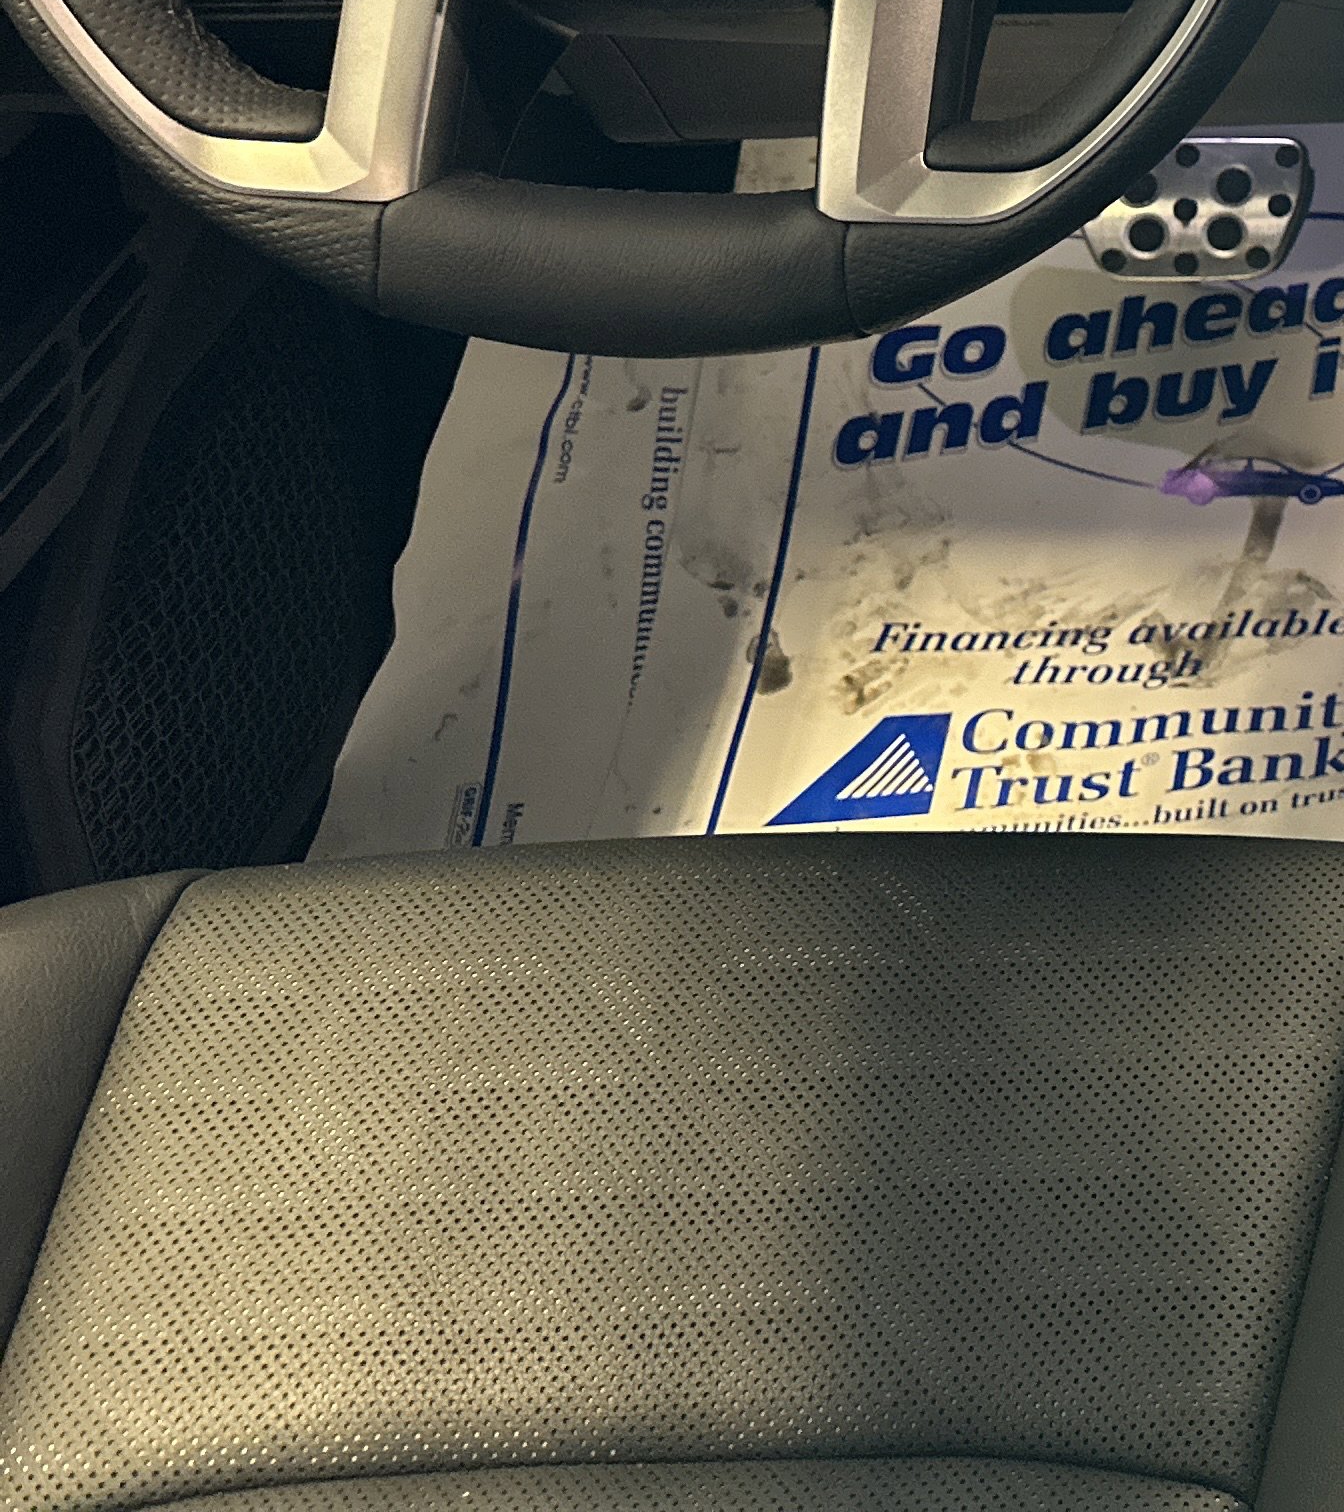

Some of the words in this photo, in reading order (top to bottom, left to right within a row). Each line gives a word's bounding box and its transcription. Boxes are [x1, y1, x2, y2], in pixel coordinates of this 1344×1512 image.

[868, 323, 1007, 387] Go
[831, 380, 1050, 473] and
[1080, 355, 1280, 438] buy
[640, 386, 689, 511] building
[871, 621, 1112, 656] Financing
[1011, 649, 1203, 688] through
[1239, 798, 1279, 816] on
